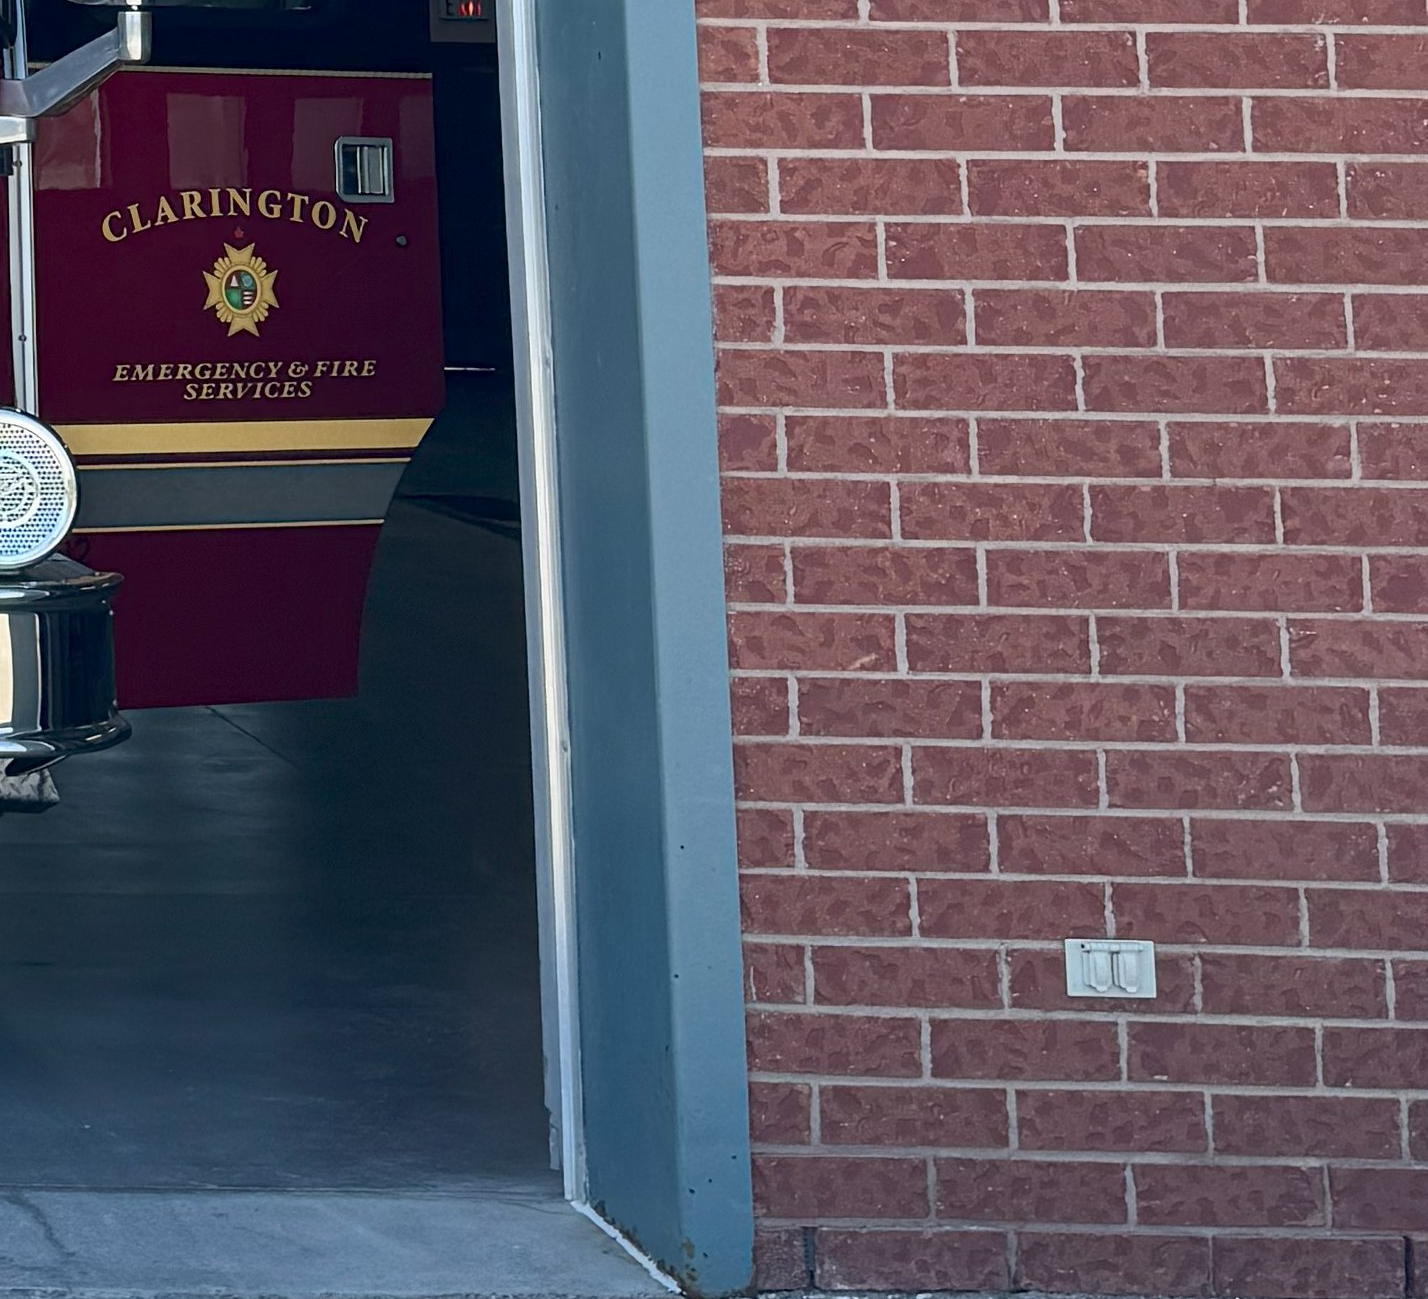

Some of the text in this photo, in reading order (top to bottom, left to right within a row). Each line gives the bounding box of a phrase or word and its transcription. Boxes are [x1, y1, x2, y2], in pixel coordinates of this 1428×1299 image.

[101, 187, 369, 244] CLARINGTON
[112, 360, 377, 382] EMERGENCY & FIRE
[183, 381, 313, 400] SERVICES
